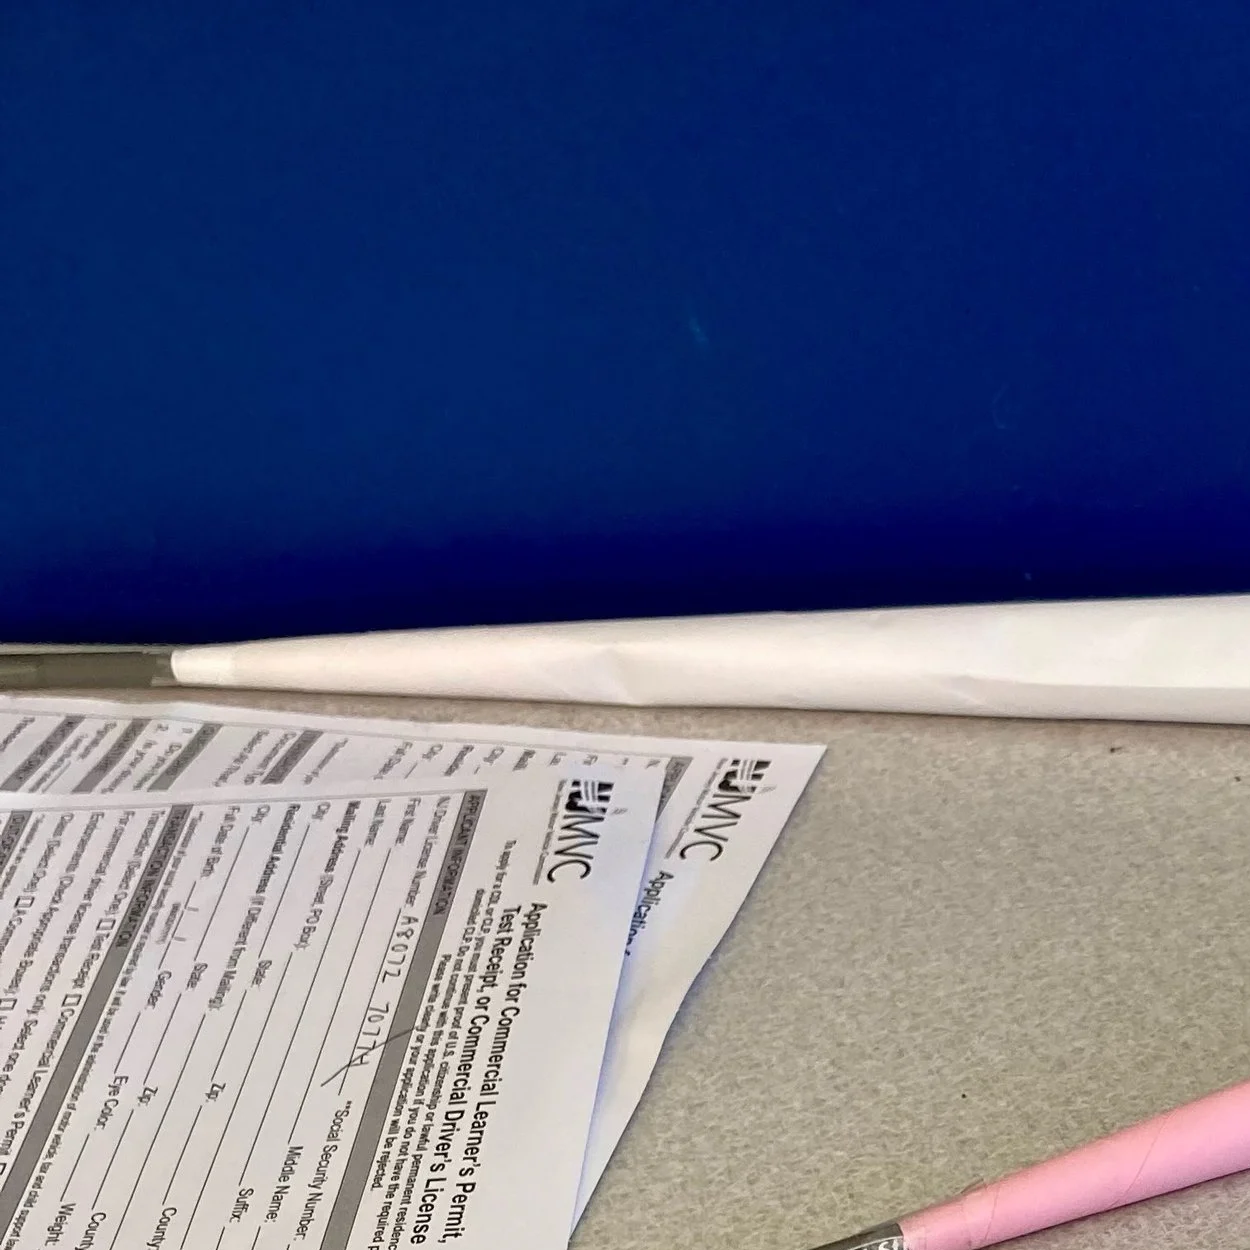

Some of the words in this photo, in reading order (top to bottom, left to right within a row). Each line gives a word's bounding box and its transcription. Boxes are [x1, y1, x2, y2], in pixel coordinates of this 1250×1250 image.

[306, 908, 322, 924] PO
[486, 908, 494, 916] or
[496, 906, 522, 934] Test
[382, 916, 419, 984] A8072
[474, 936, 484, 952] you
[510, 902, 548, 980] Application
[434, 954, 452, 982] Please
[452, 958, 464, 972] not
[476, 936, 512, 992] Receipt,
[428, 982, 440, 1004] write
[440, 974, 460, 1010] continue
[458, 974, 474, 1006] present
[474, 996, 490, 1012] or
[504, 982, 528, 1002] for
[414, 1004, 434, 1032] clearly
[436, 1010, 448, 1028] with
[450, 1006, 464, 1030] proof
[38, 1008, 74, 1068] Commercial
[416, 1034, 424, 1044] or
[430, 1030, 444, 1046] this
[448, 1030, 458, 1040] of
[408, 1046, 422, 1066] your
[442, 1042, 456, 1060] U.S.
[448, 1014, 490, 1106] Commercial
[480, 1006, 520, 1096] Commercial
[108, 1076, 128, 1096] Eye
[416, 1048, 436, 1096] application
[426, 1062, 448, 1110] citizenship
[392, 1068, 414, 1116] application
[412, 1098, 426, 1106] if
[388, 1118, 400, 1134] will
[408, 1106, 420, 1124] you
[424, 1112, 434, 1122] or
[384, 1136, 398, 1148] be
[404, 1126, 416, 1140] do
[416, 1124, 434, 1152] lawful
[430, 1110, 464, 1172] Driver's
[458, 1100, 496, 1176] Learner's
[398, 1140, 410, 1156] not
[278, 1146, 304, 1182] Middle
[308, 1144, 338, 1190] Security
[370, 1150, 390, 1192] rejected.
[390, 1158, 408, 1182] have
[386, 1182, 400, 1198] the
[400, 1154, 422, 1206] permanent
[230, 1188, 254, 1222] Suffix:
[264, 1186, 290, 1222] Name:
[294, 1192, 324, 1240] Number:
[410, 1178, 446, 1244] License
[438, 1182, 476, 1244] Permit,
[10, 1210, 30, 1238] support
[44, 1204, 76, 1246] Weight:
[146, 1208, 178, 1250] County:
[372, 1202, 392, 1242] required
